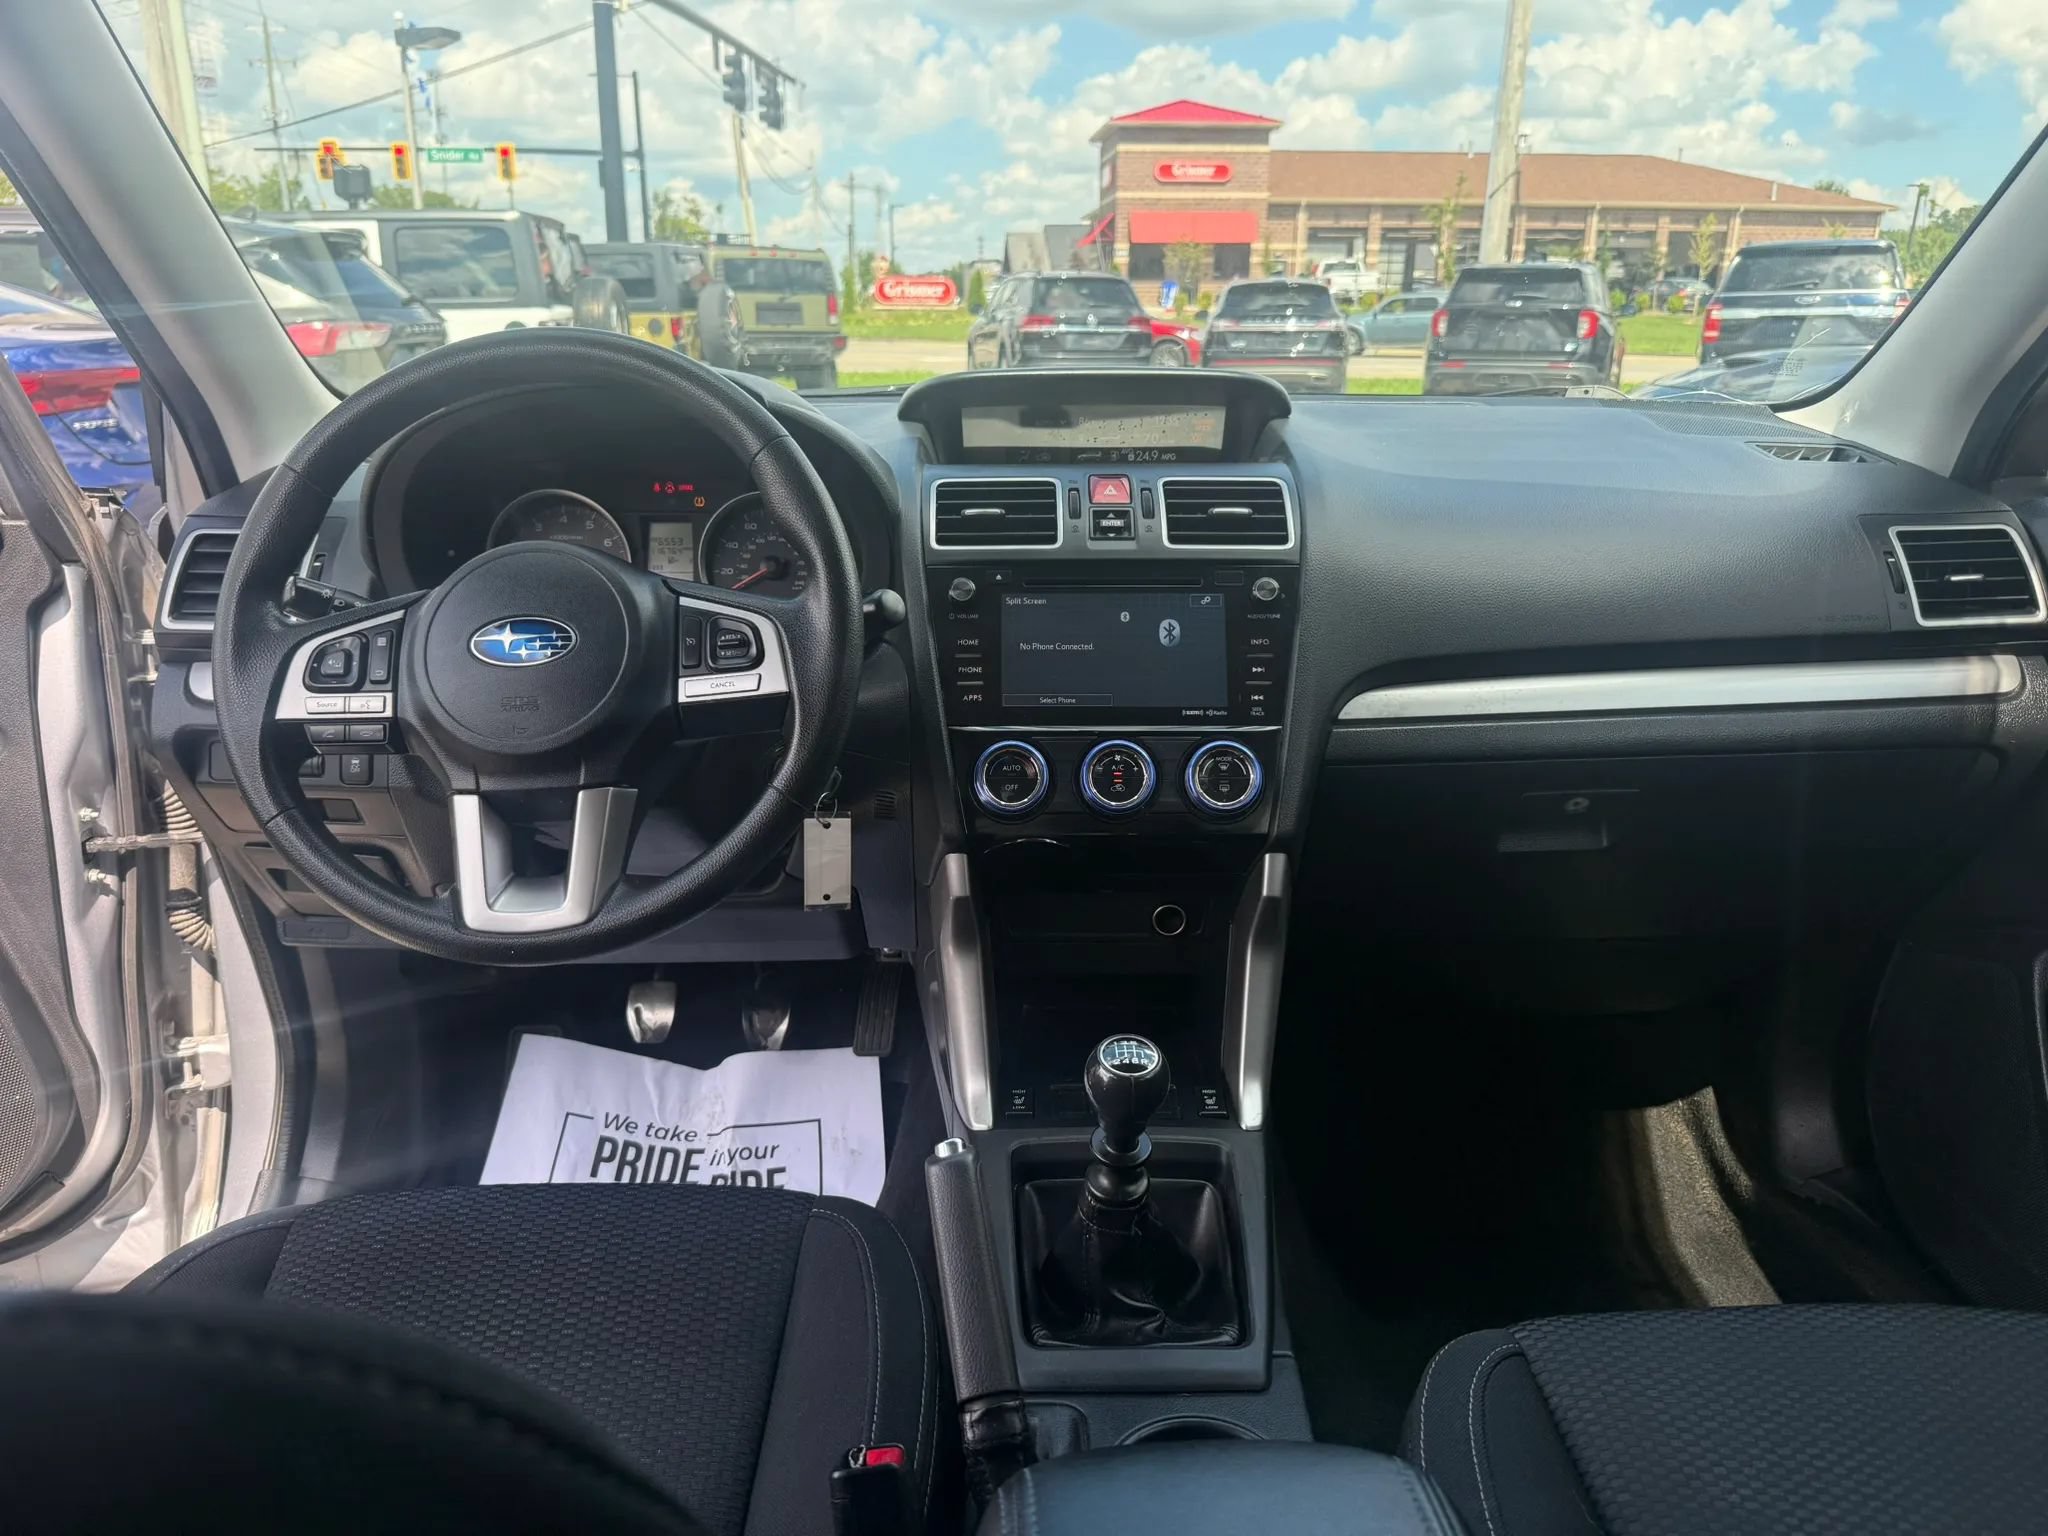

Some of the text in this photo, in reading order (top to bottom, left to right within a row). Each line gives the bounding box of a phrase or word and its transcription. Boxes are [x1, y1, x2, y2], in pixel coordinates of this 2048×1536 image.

[431, 150, 464, 161] Snider
[1136, 450, 1177, 461] 24.9 MPG
[586, 520, 595, 530] 5
[603, 538, 613, 547] 6
[720, 567, 734, 575] 20
[1006, 597, 1047, 606] Split Screen
[1032, 642, 1054, 650] Phone
[1055, 642, 1095, 650] Connected.
[710, 681, 736, 689] CANCEL
[1040, 696, 1057, 704] Select
[604, 1112, 698, 1143] We take
[590, 1135, 706, 1185] PRIDE
[727, 1144, 781, 1168] your
